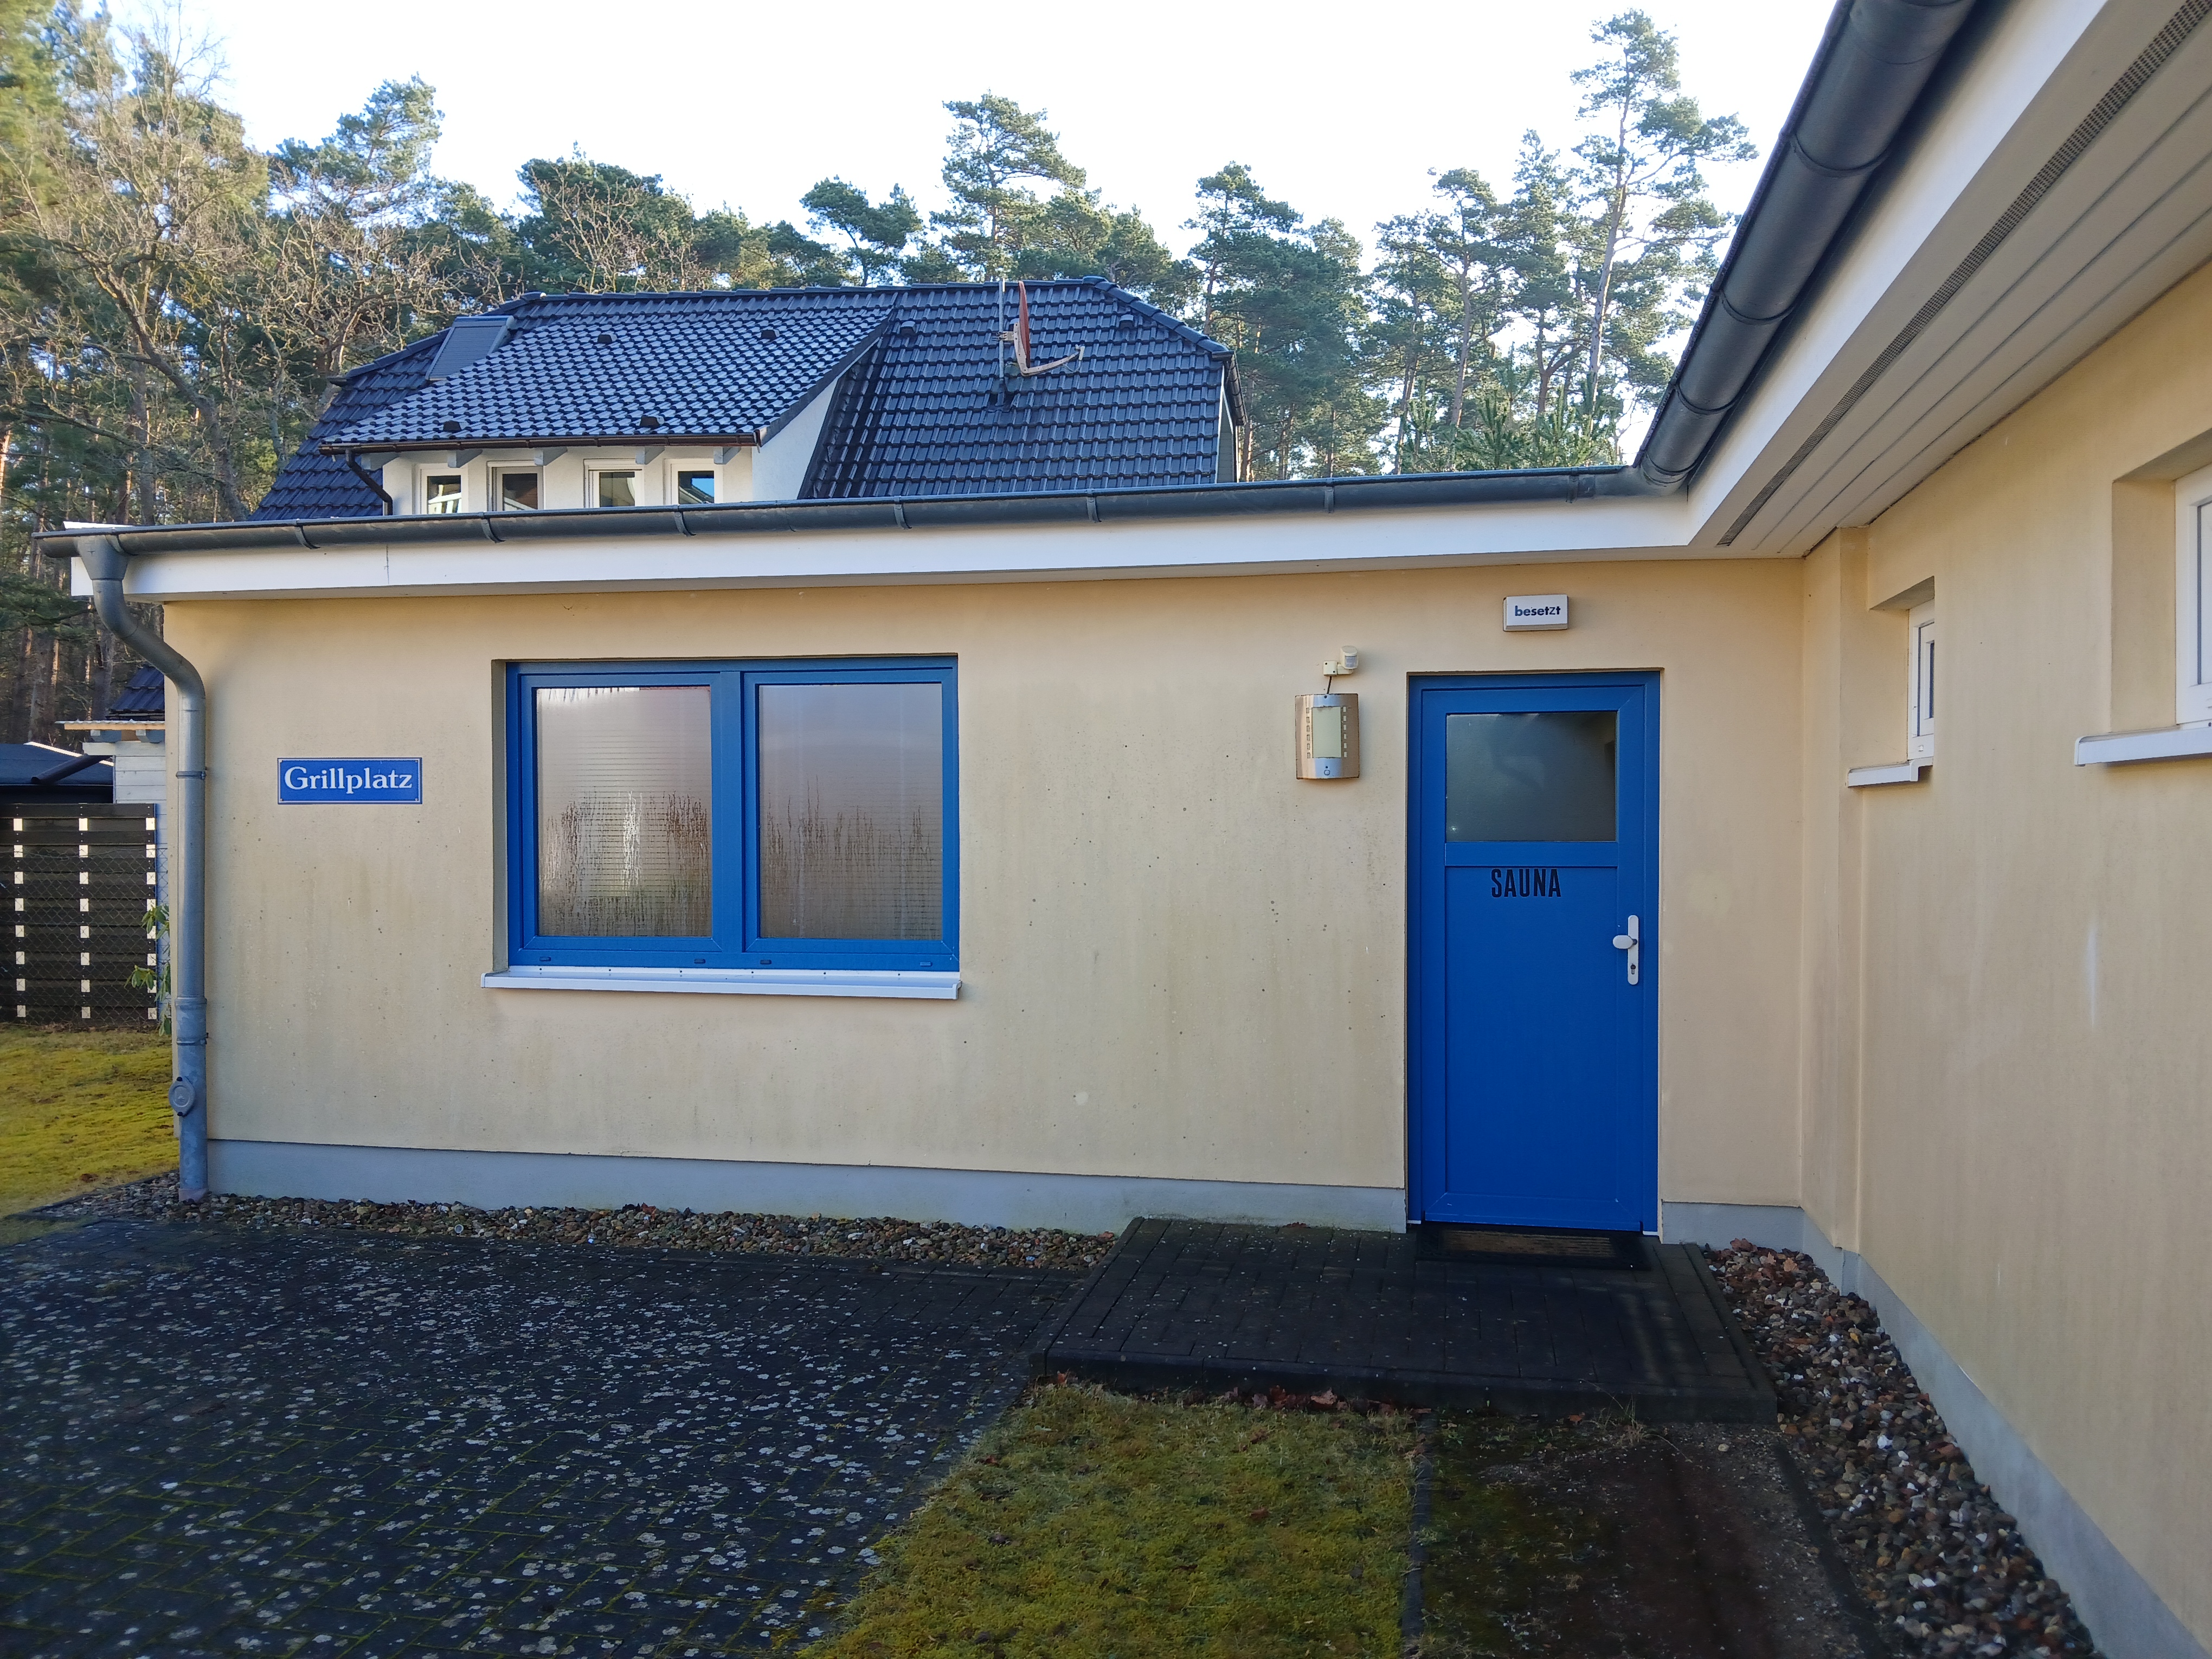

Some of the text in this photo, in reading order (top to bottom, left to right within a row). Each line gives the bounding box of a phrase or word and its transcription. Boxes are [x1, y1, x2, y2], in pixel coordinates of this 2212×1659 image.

[1515, 605, 1561, 616] besetzt
[284, 766, 413, 794] Grillplatz
[1491, 869, 1561, 898] SAUNA
